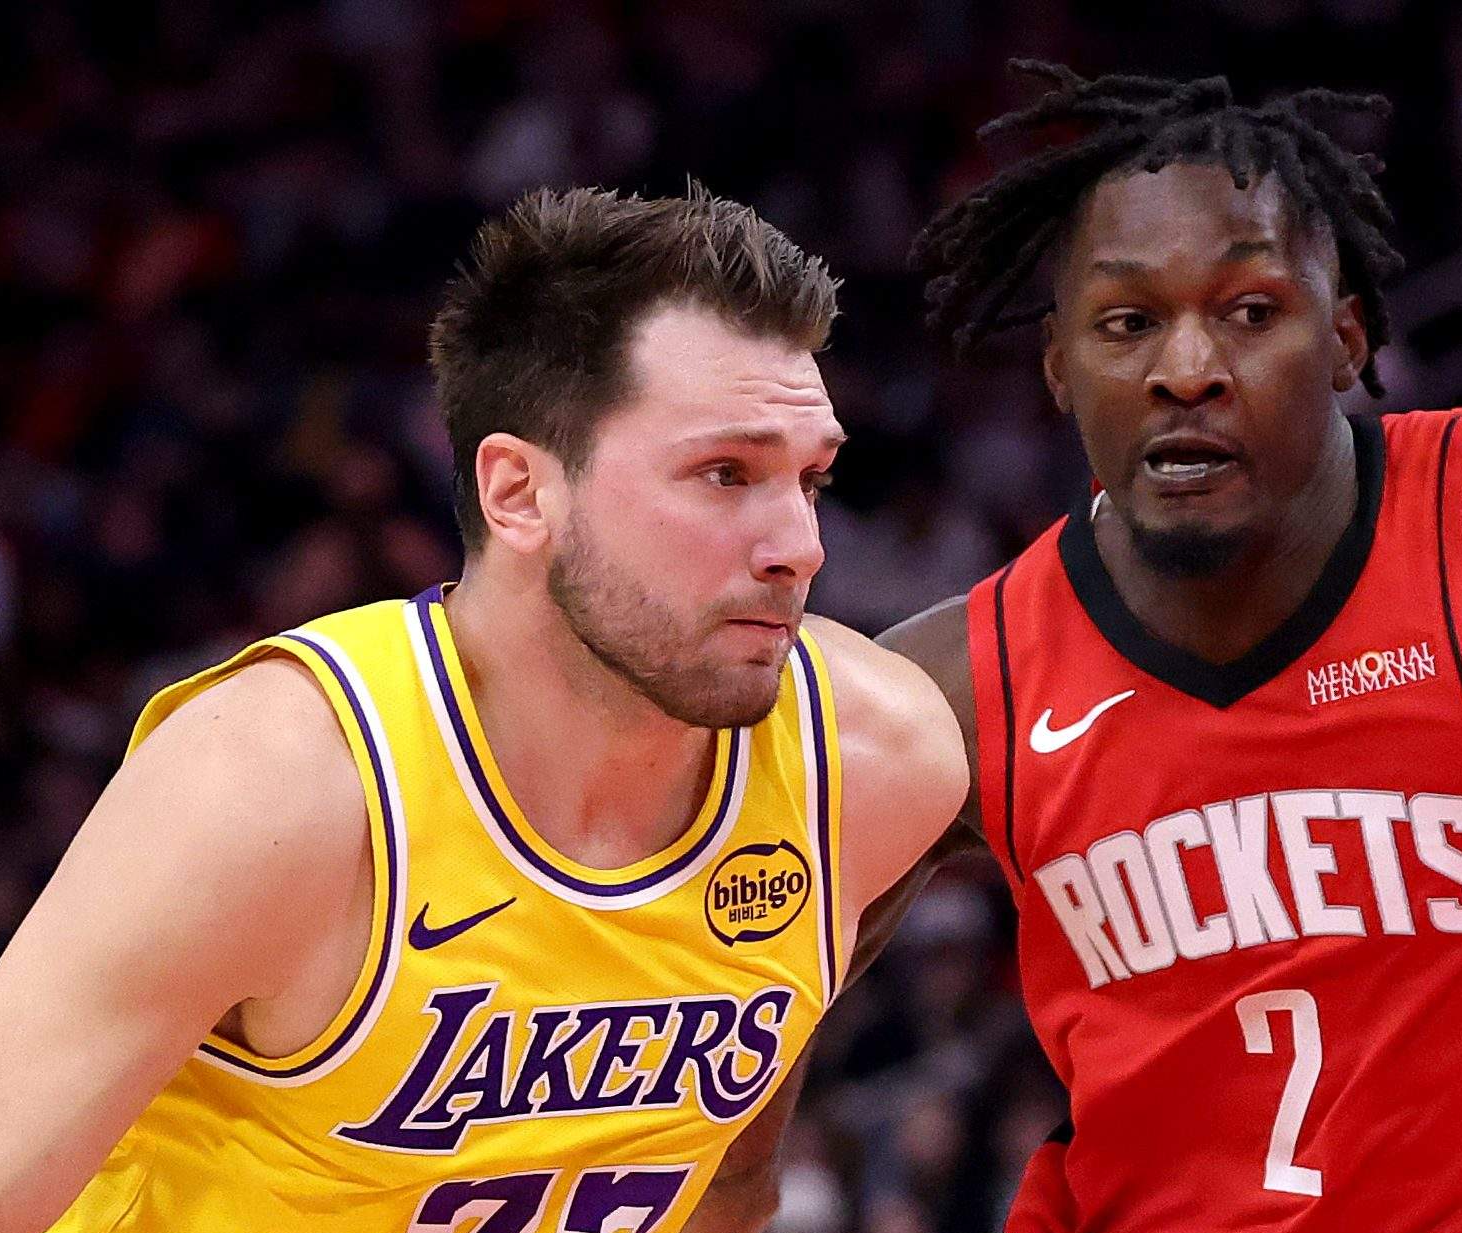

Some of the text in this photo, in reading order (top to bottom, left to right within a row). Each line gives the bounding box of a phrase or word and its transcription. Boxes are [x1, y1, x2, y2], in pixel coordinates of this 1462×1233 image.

[1307, 641, 1435, 687] MEMORIAL
[1309, 659, 1436, 706] HERMANN
[714, 868, 804, 910] bibigo
[728, 903, 768, 924] 비비고
[330, 980, 797, 1155] LAKERS
[1235, 988, 1323, 1197] 2
